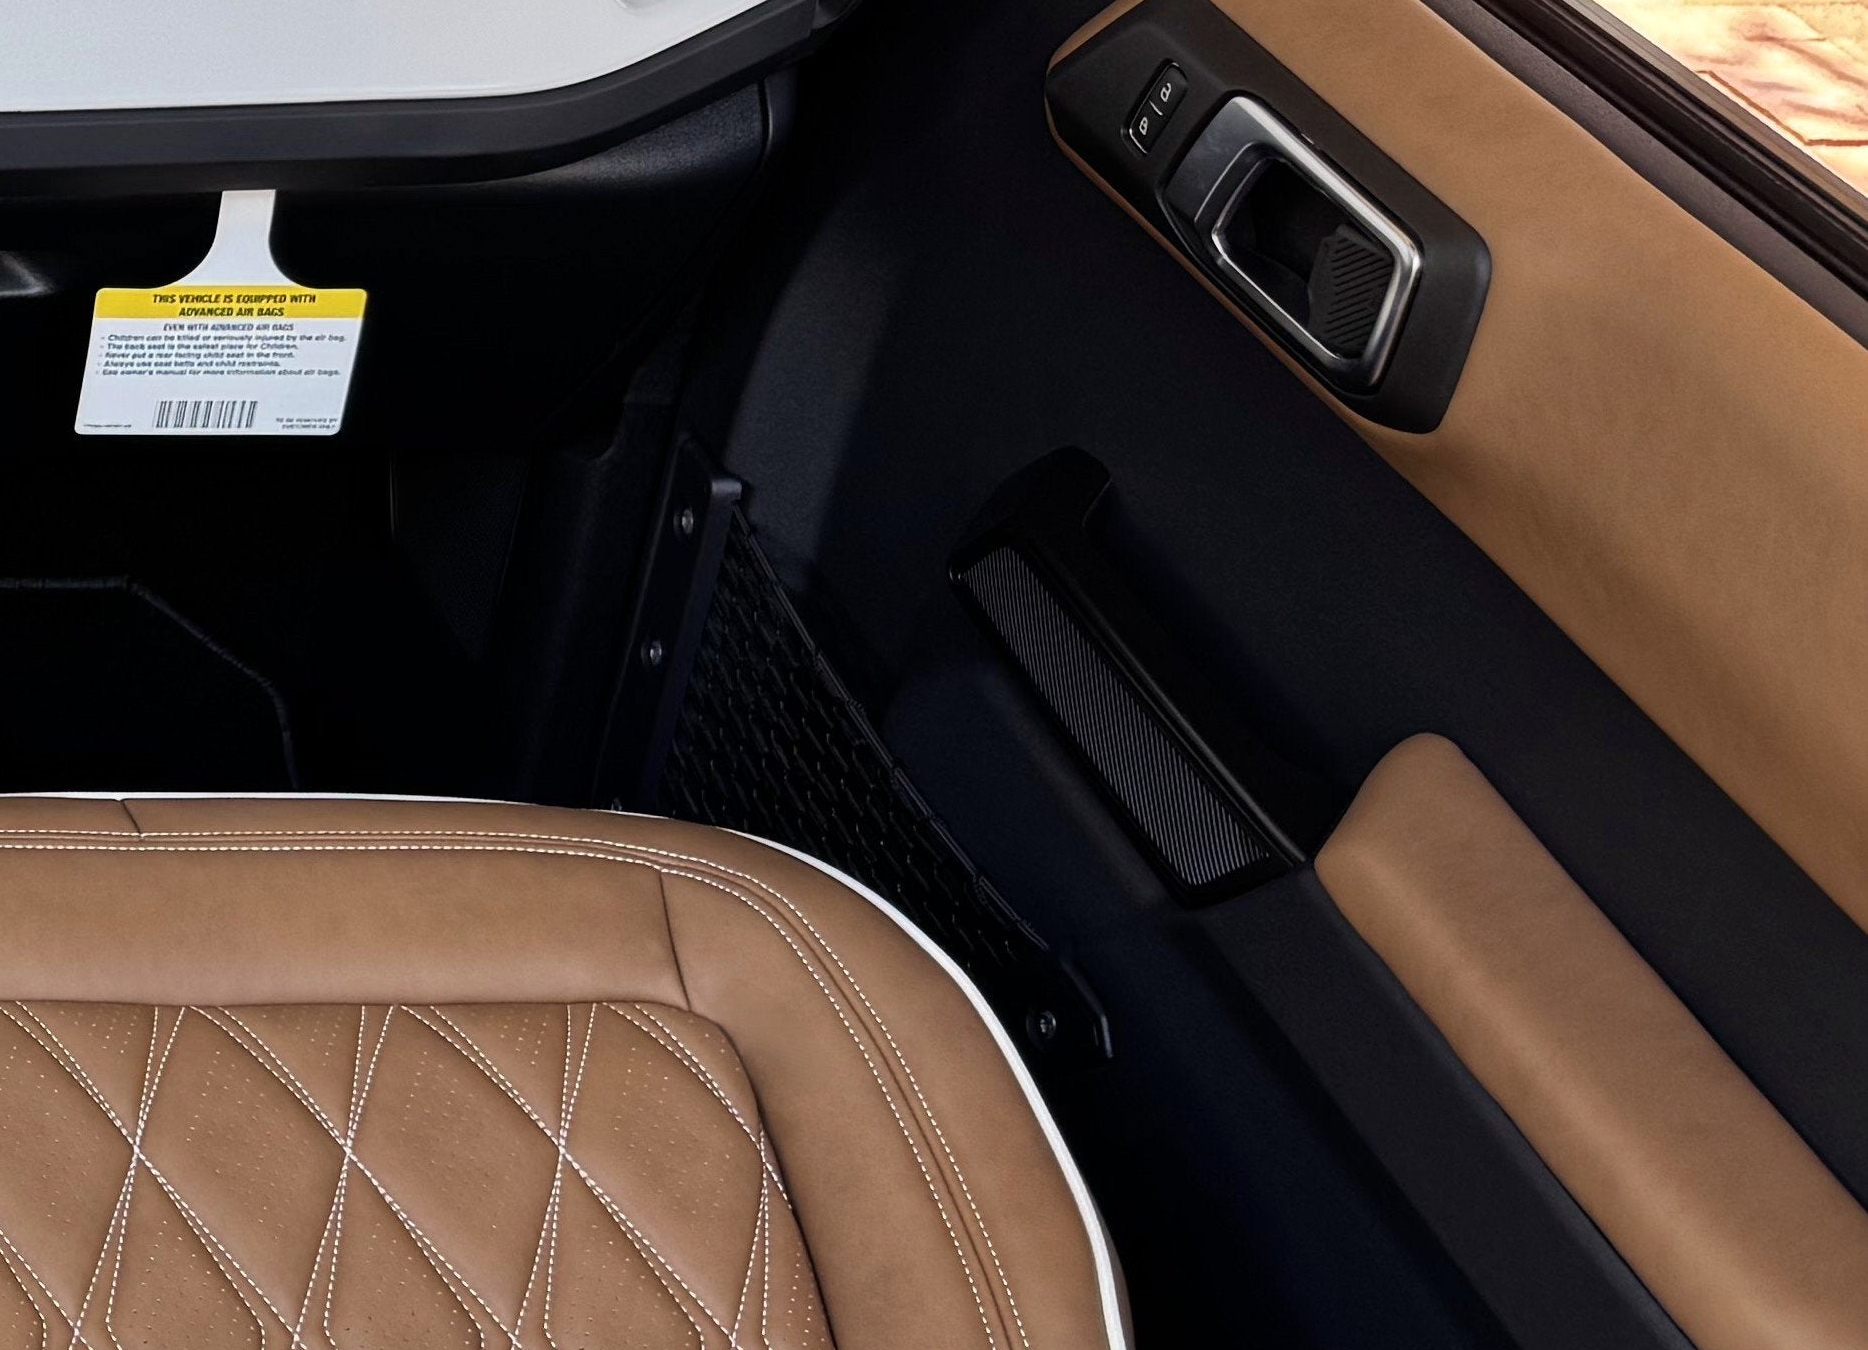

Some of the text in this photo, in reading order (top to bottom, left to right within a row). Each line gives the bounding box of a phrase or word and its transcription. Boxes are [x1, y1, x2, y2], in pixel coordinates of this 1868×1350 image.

[153, 294, 316, 304] THIS VEHICLE IS EQUIPPED WITH
[179, 307, 285, 317] ADVANCED AIR BAGS
